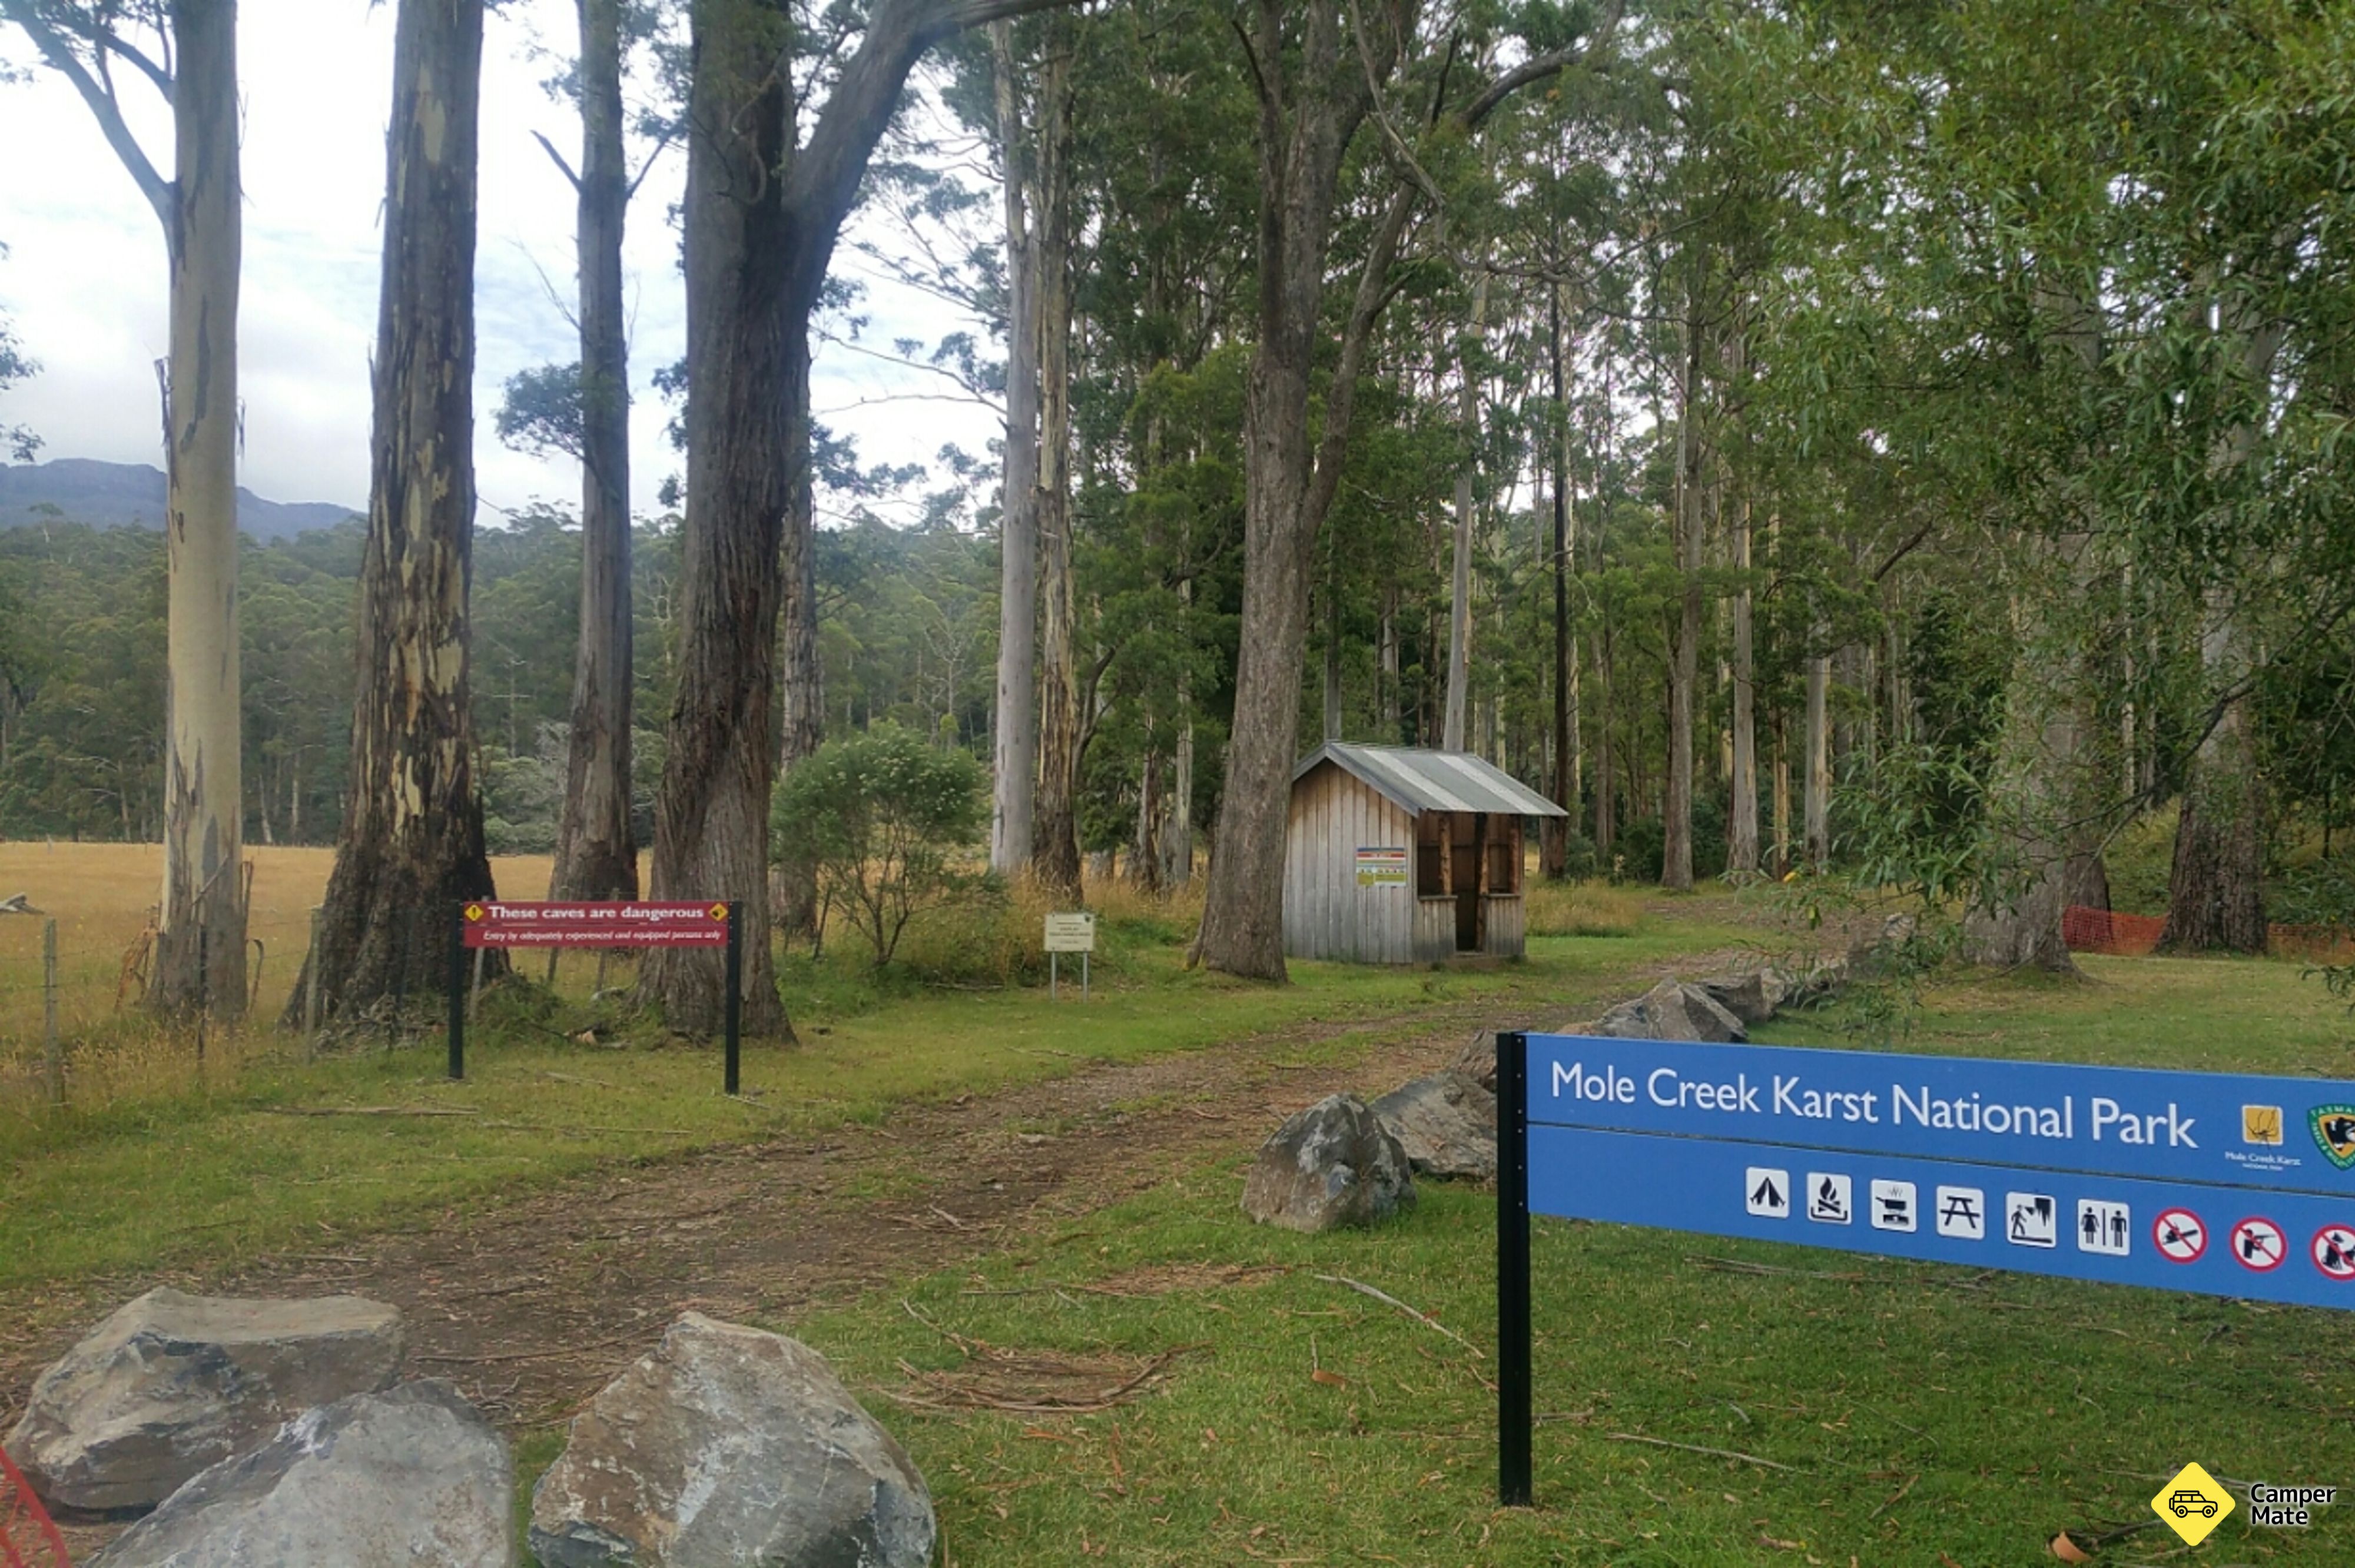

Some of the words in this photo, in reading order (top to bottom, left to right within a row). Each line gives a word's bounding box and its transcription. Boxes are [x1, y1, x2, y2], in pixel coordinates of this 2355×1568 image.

[487, 905, 538, 919] These
[542, 909, 585, 919] caves
[589, 909, 616, 918] are
[620, 906, 704, 922] dangerous
[483, 930, 506, 942] Entry
[508, 931, 518, 942] by
[519, 931, 563, 942] adequately
[565, 931, 613, 941] experienced
[615, 931, 631, 940] and
[632, 931, 670, 941] equipped
[671, 931, 702, 941] persons
[704, 930, 721, 941] only
[1552, 1061, 1635, 1103] Mole
[1647, 1068, 1761, 1112] Creek
[1773, 1075, 1879, 1123] Karst
[1892, 1084, 2073, 1139] National
[2091, 1097, 2200, 1149] Park
[2310, 1105, 2355, 1117] TASMA
